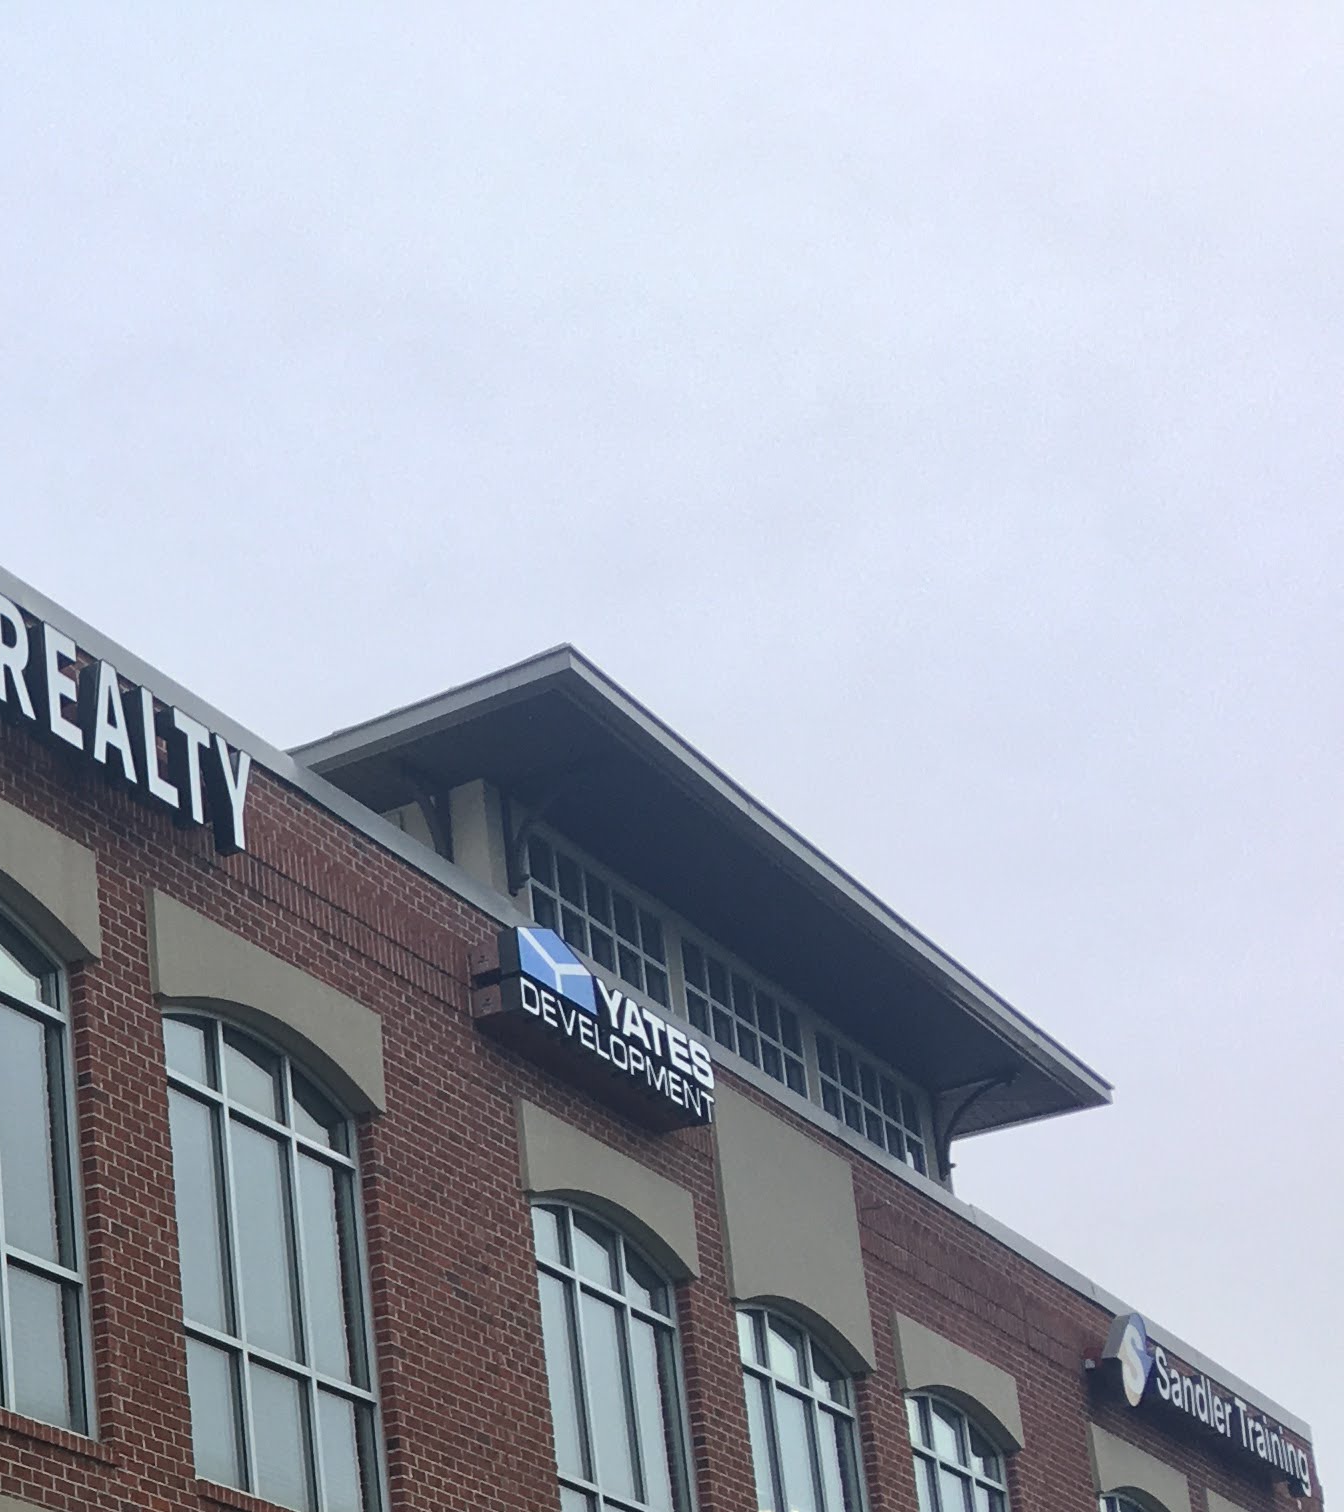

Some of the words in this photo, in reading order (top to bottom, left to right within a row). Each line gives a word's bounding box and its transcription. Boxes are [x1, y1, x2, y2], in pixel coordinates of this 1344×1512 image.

[520, 977, 715, 1123] DEVELOPMENT
[597, 977, 715, 1090] YATES
[1154, 1347, 1232, 1437] Sandler
[1234, 1397, 1312, 1497] Training
